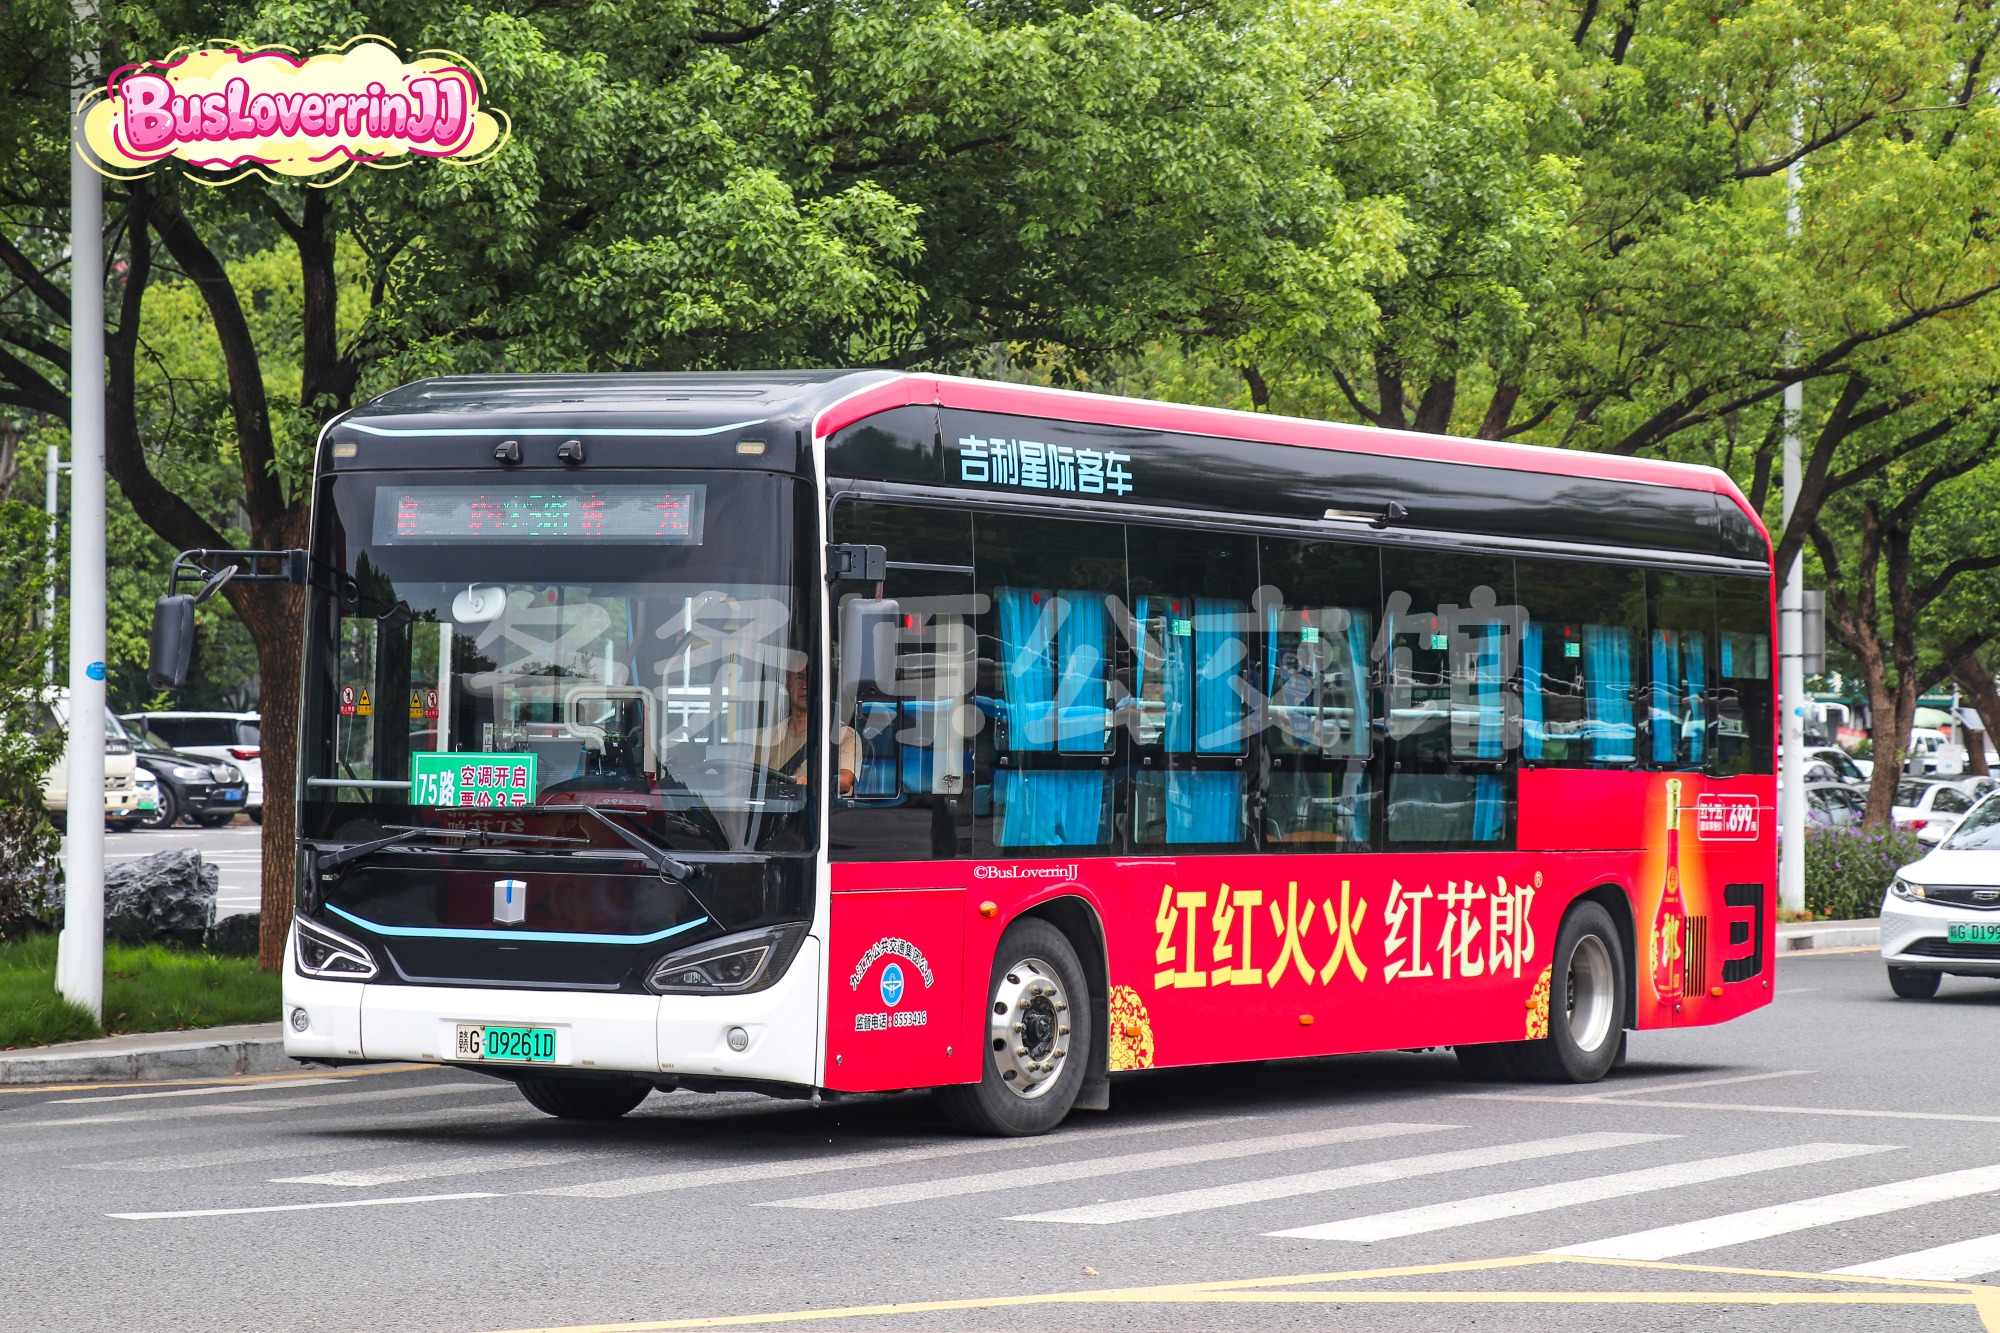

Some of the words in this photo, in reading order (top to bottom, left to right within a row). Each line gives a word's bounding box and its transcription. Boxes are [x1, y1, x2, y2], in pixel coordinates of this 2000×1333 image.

[958, 434, 1134, 497] 吉利星际客车
[418, 769, 456, 806] 75路
[460, 764, 527, 788] 空调开启
[1154, 880, 1368, 990] 红红火火
[850, 937, 935, 991] 九江市公共交通集团公司
